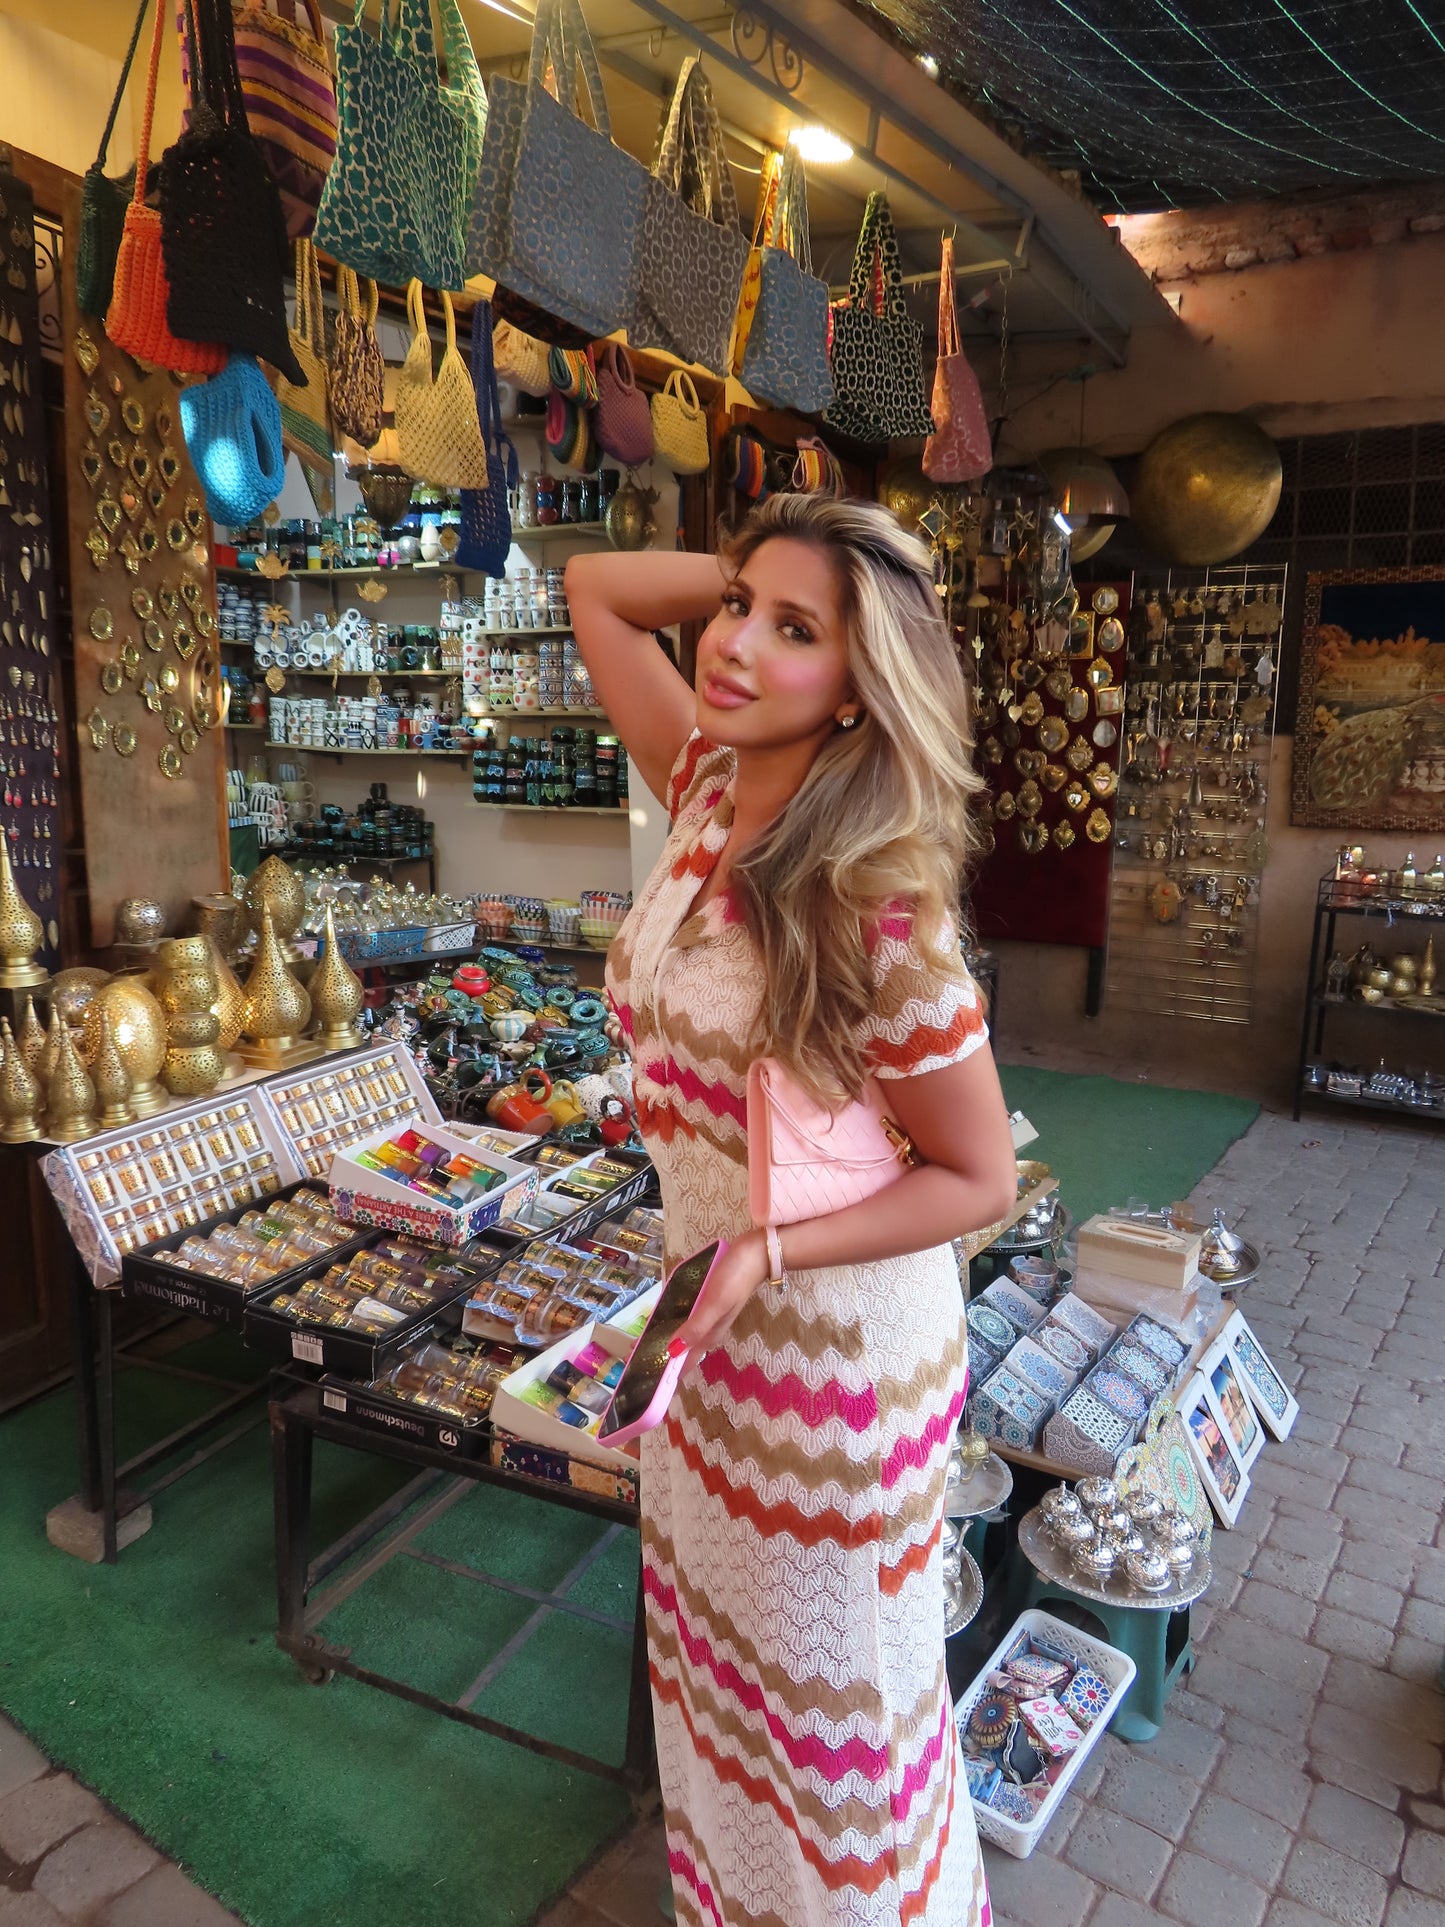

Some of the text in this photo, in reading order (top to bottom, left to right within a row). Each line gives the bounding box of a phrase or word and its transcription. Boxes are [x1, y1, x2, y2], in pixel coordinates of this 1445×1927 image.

[356, 1196, 392, 1212] ARTISANAL
[414, 1211, 436, 1223] VERRE
[134, 1280, 208, 1315] Traditionnel
[213, 1304, 230, 1322] Le
[356, 1405, 425, 1437] Deutschmann
